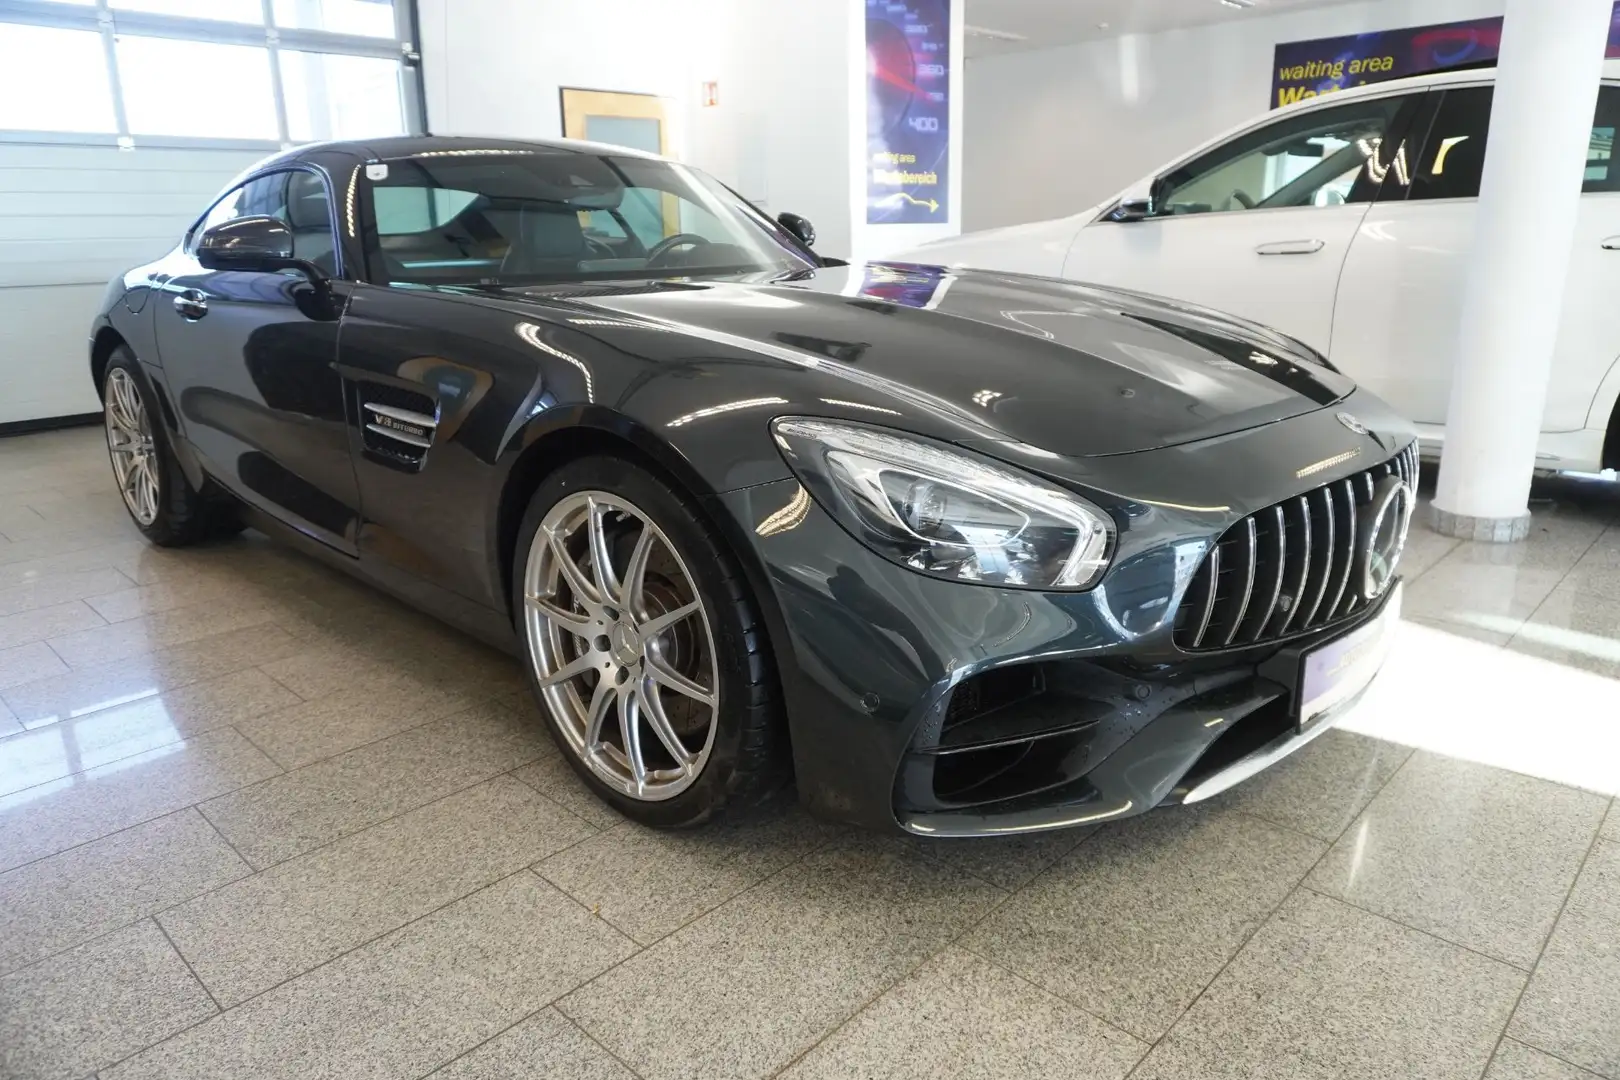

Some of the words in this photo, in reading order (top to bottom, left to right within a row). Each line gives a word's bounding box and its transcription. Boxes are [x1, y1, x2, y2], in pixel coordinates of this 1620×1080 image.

[1280, 60, 1346, 80] waiting
[1348, 56, 1393, 74] area
[909, 116, 939, 131] 400
[873, 169, 937, 185] bereich
